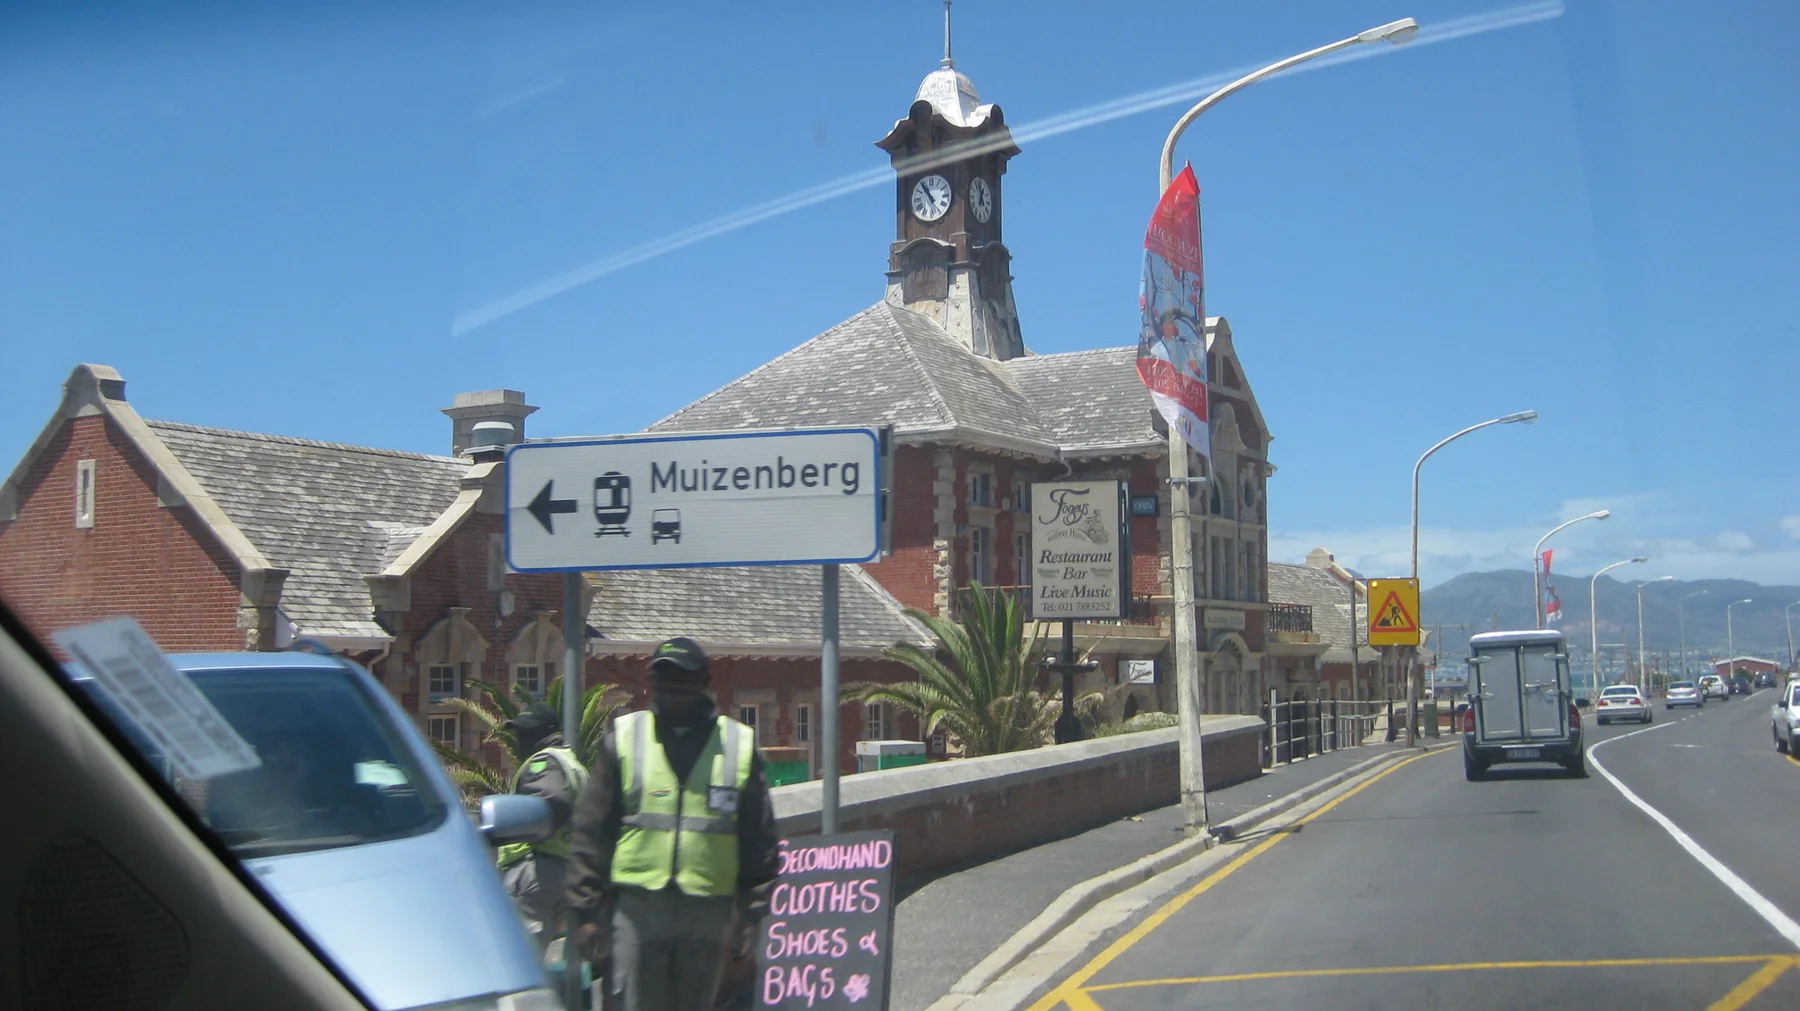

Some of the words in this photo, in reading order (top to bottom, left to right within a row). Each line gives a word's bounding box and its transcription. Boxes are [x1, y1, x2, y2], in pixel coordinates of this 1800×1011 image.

[651, 456, 860, 495] Muizenberg
[1038, 488, 1090, 526] Fogeys
[1038, 550, 1112, 564] Restaurant
[1062, 567, 1088, 580] Bar
[1040, 584, 1069, 599] Live
[1070, 584, 1112, 598] Music
[1042, 602, 1057, 612] Tel:
[1058, 602, 1073, 611] 021
[778, 839, 892, 875] SECONDHAND
[770, 879, 881, 915] CLOTHES
[766, 921, 848, 959] SHOES
[763, 964, 835, 1007] BAGS
